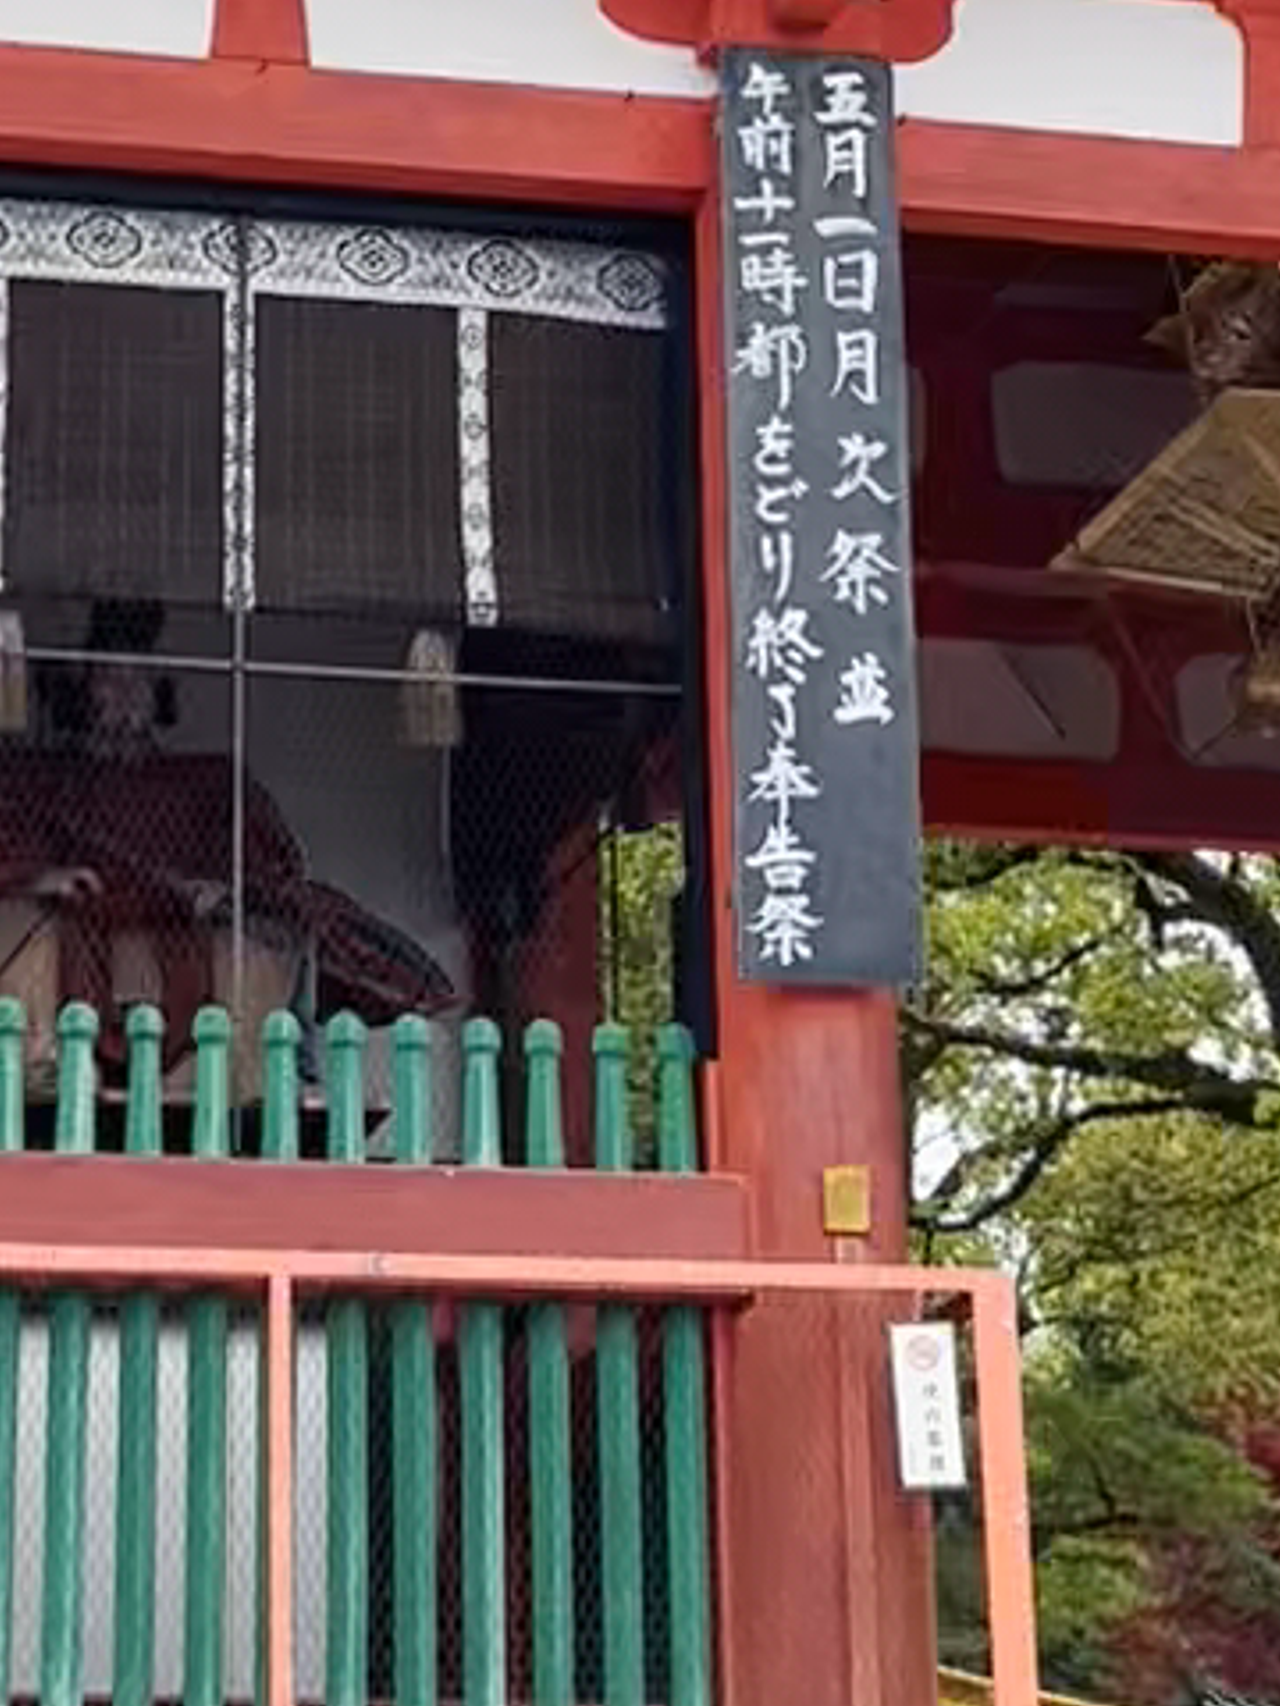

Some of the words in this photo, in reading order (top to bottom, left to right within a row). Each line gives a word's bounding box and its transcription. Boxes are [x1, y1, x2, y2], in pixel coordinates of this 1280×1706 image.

[814, 71, 901, 726] 五月一日月次祭並
